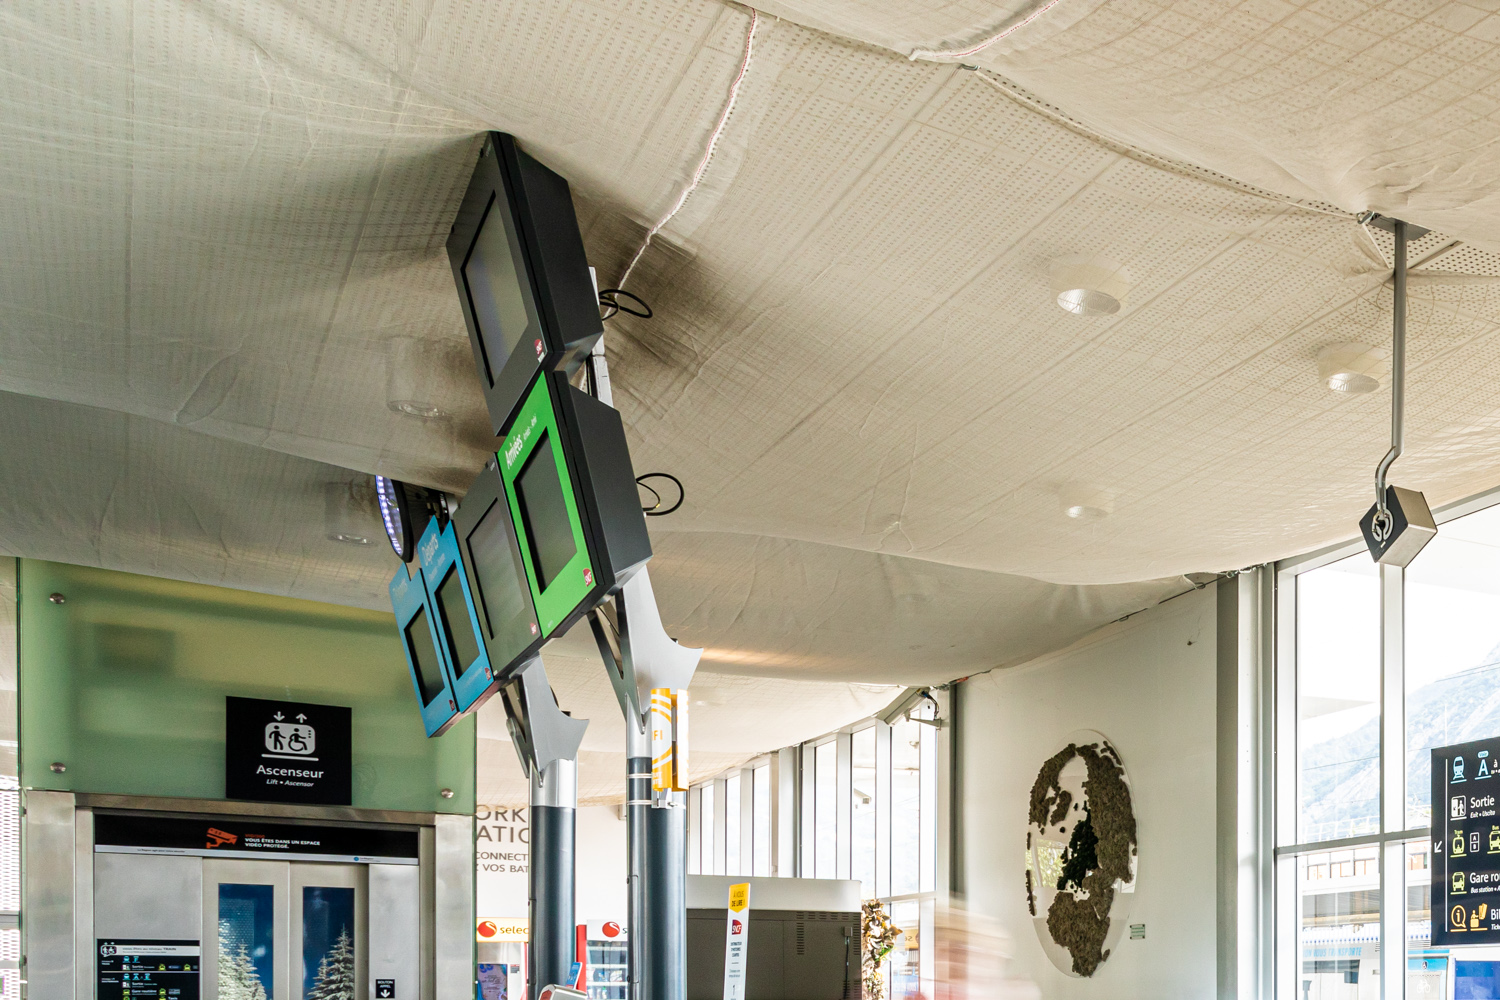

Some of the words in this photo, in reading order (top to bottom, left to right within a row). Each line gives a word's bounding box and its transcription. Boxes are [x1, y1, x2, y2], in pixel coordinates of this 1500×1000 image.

[256, 765, 324, 778] Ascenseur
[1478, 759, 1488, 776] A
[1493, 759, 1498, 768] à
[1470, 795, 1495, 809] Sortie
[483, 864, 505, 872] VOS
[1470, 872, 1489, 884] Gare
[732, 925, 742, 933] SNCF
[1328, 947, 1362, 957] TRNSPORTE
